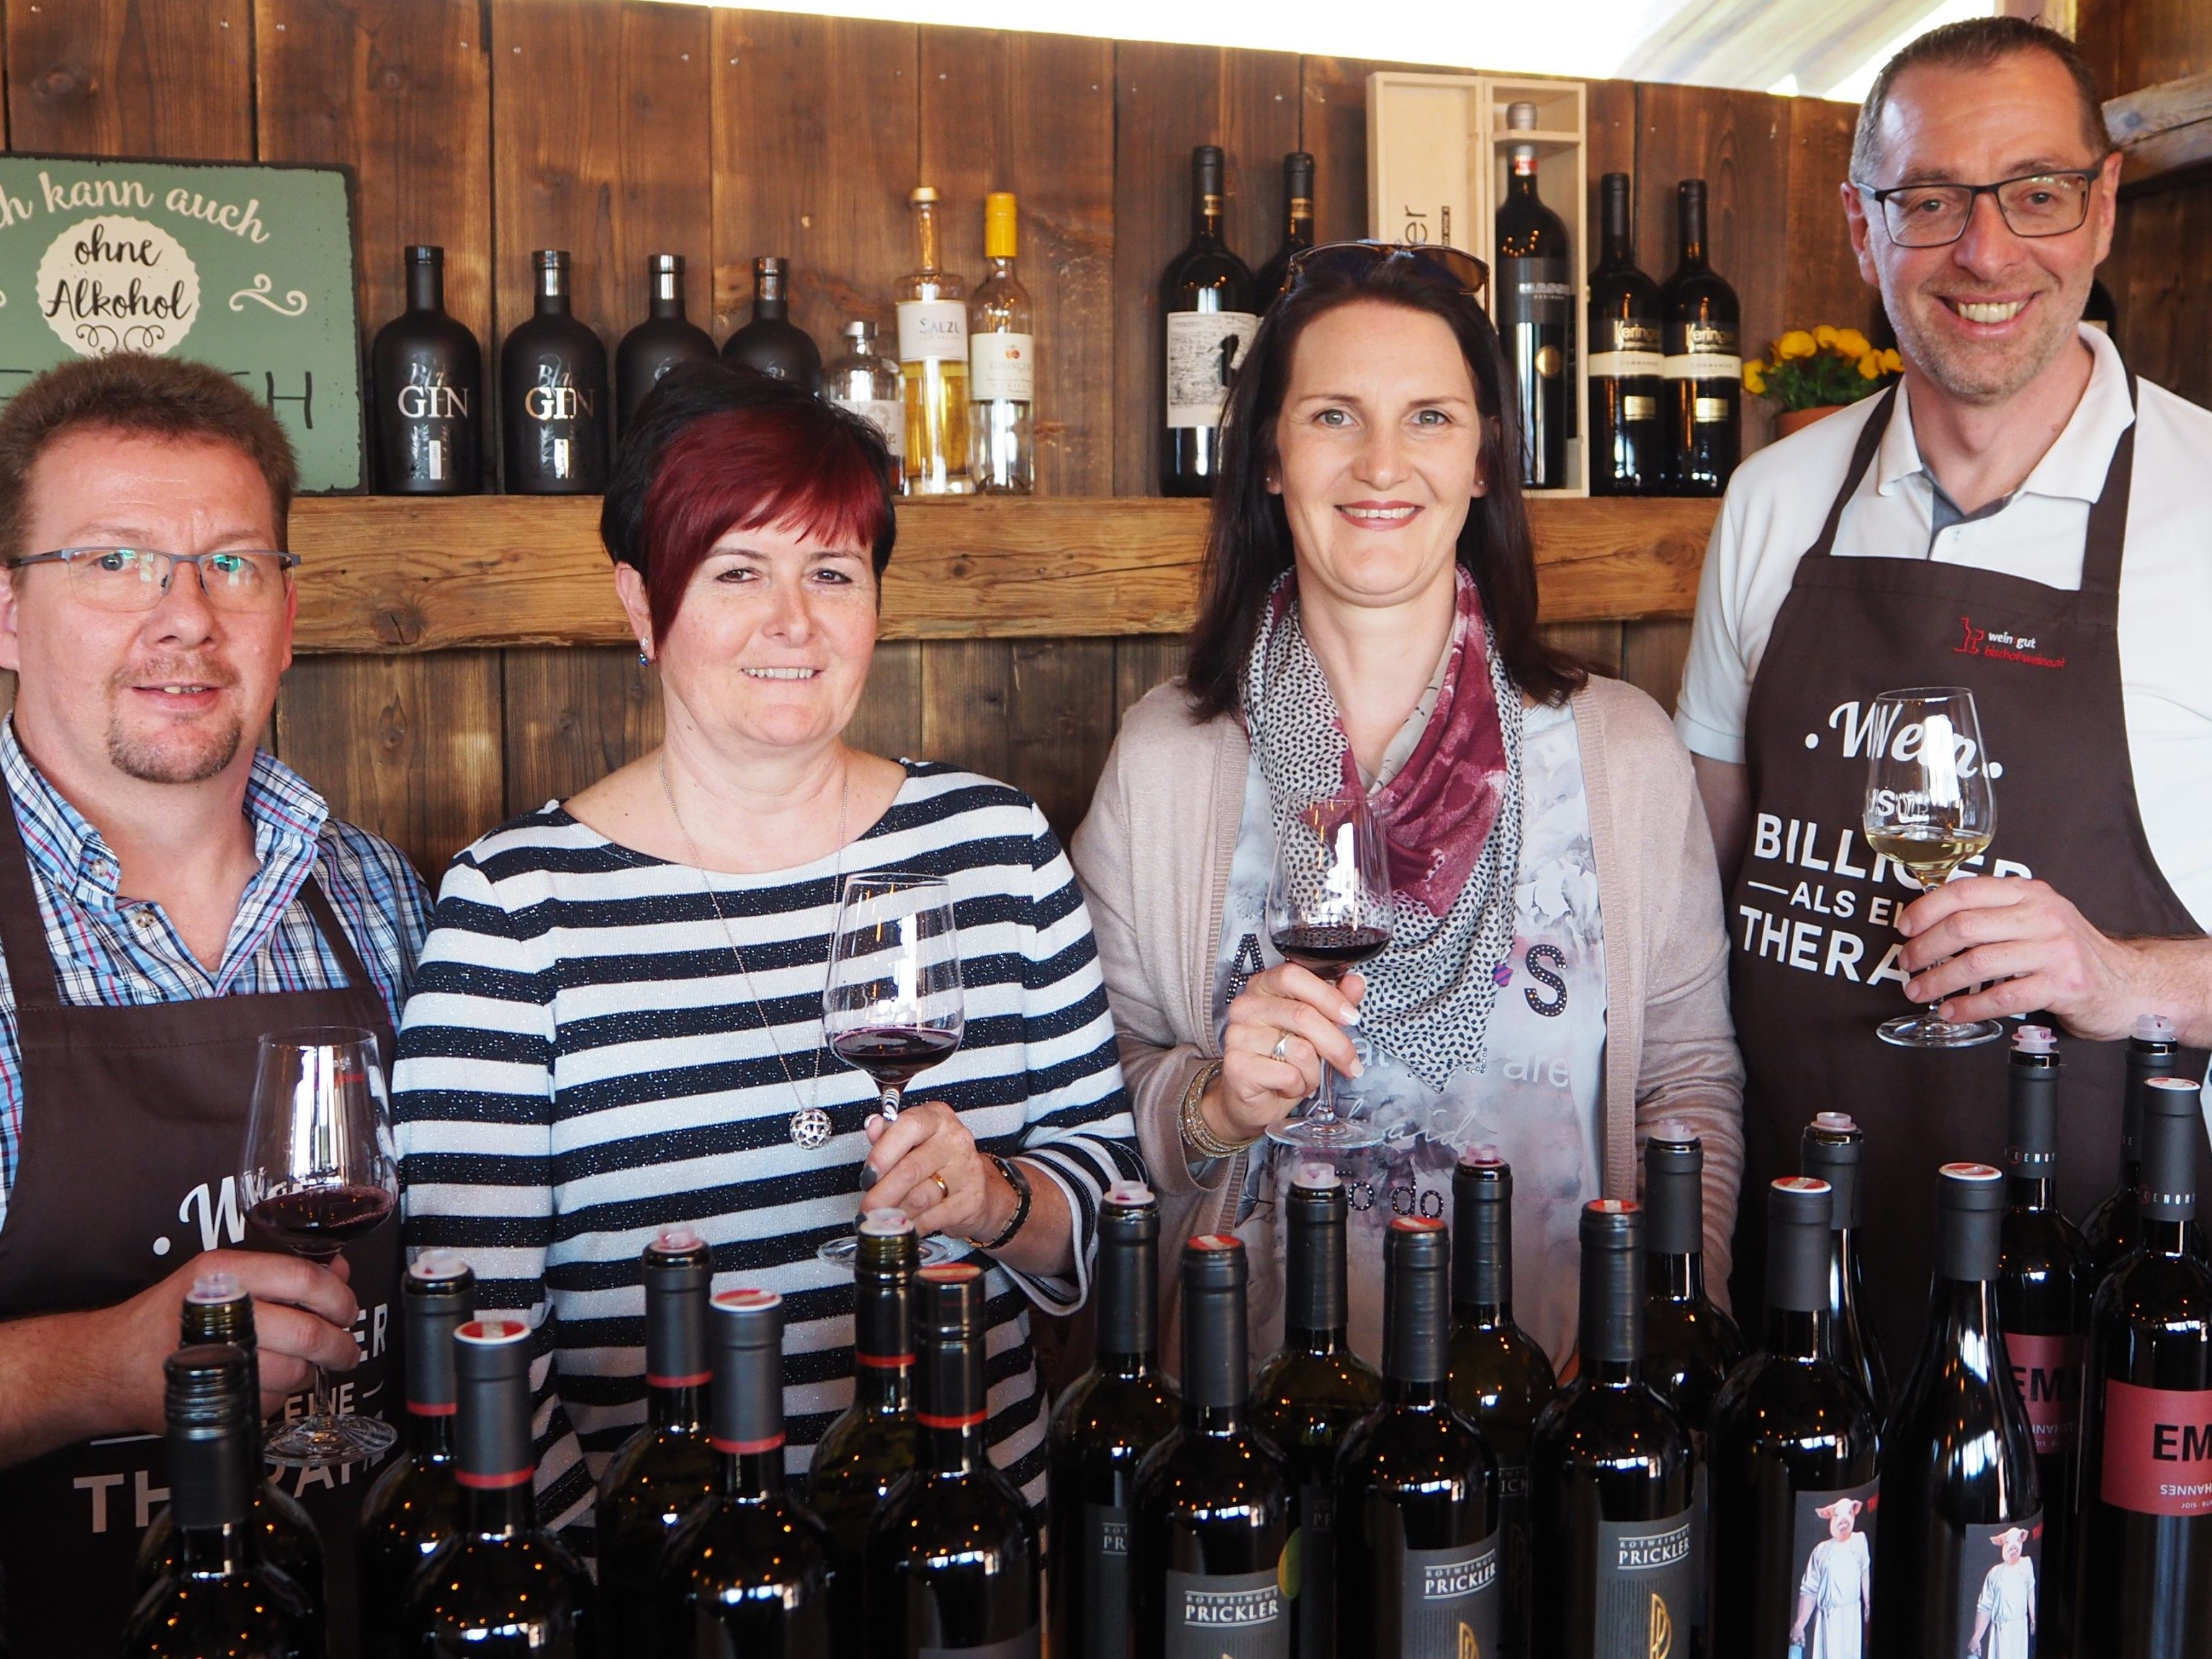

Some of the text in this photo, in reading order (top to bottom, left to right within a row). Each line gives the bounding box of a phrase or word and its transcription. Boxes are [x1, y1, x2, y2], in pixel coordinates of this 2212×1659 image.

[38, 171, 154, 213] kann
[165, 187, 270, 244] auch
[74, 223, 162, 266] ohne
[45, 276, 192, 321] Alkohol
[397, 385, 469, 419] GIN
[525, 386, 595, 420] GIN
[1828, 701, 1979, 779] Wen
[1789, 881, 1905, 929] ALS EI
[1502, 1051, 1569, 1088] are
[1392, 1178, 1444, 1219] do
[2153, 1424, 2212, 1462] EM
[1619, 1536, 1690, 1565] PRICKLER
[1425, 1562, 1496, 1594] PRICKLER
[1185, 1599, 1279, 1623] PRICKLER
